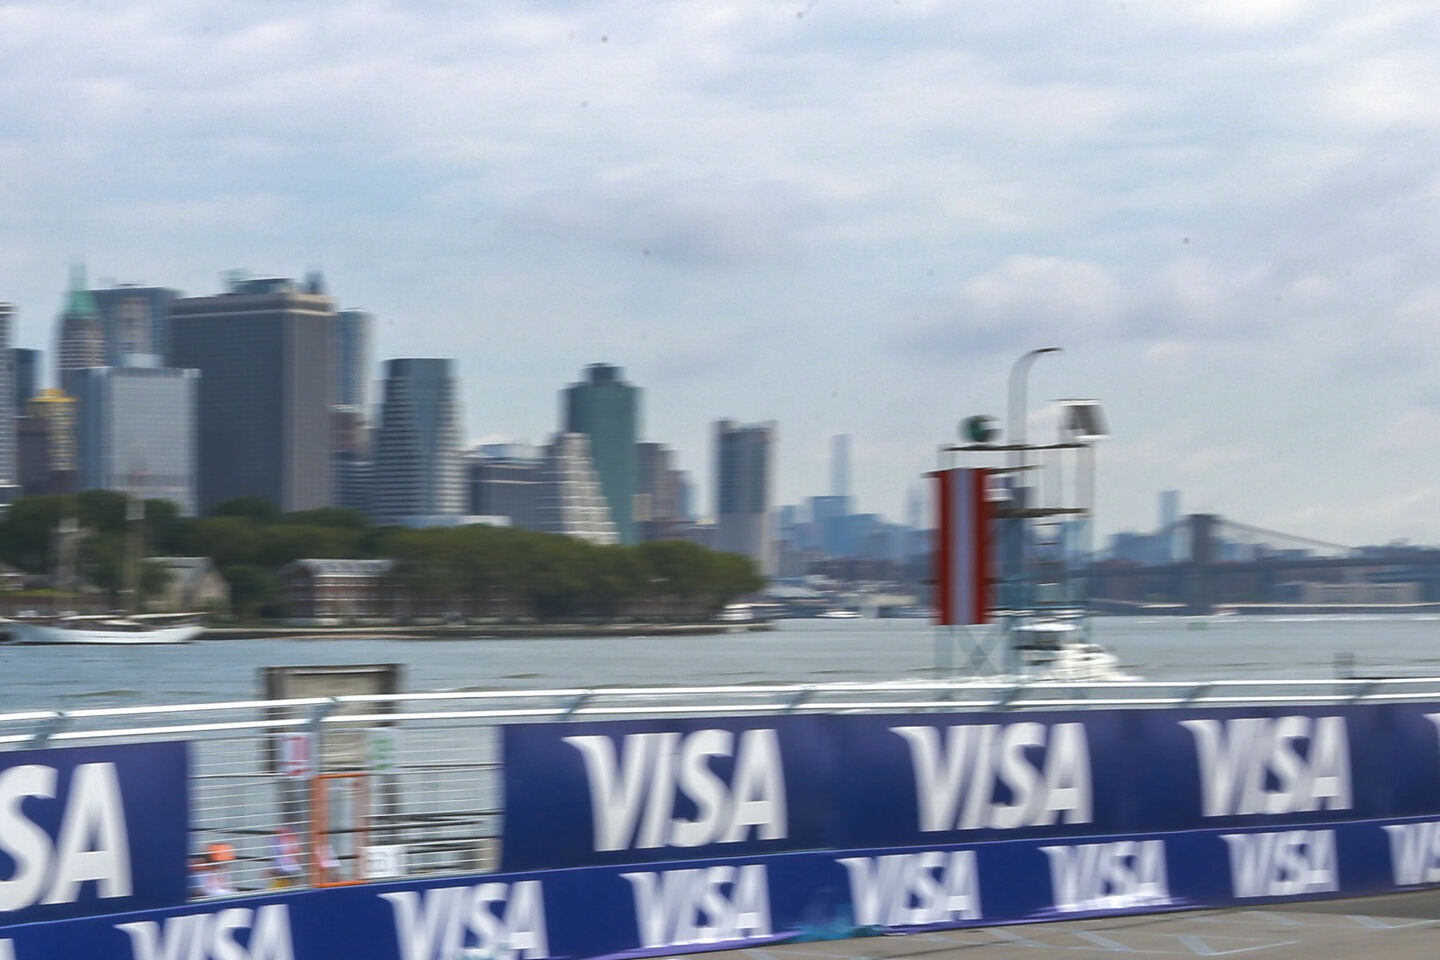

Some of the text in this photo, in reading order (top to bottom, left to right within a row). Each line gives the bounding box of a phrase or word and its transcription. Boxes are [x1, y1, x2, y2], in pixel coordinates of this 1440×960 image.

[563, 729, 788, 851] VISA
[889, 722, 1092, 832] VISA
[1179, 715, 1352, 817] VISA
[835, 850, 982, 926] VISA
[1038, 840, 1171, 912] VISA
[1218, 829, 1340, 898] VISA
[618, 865, 774, 948] VISA
